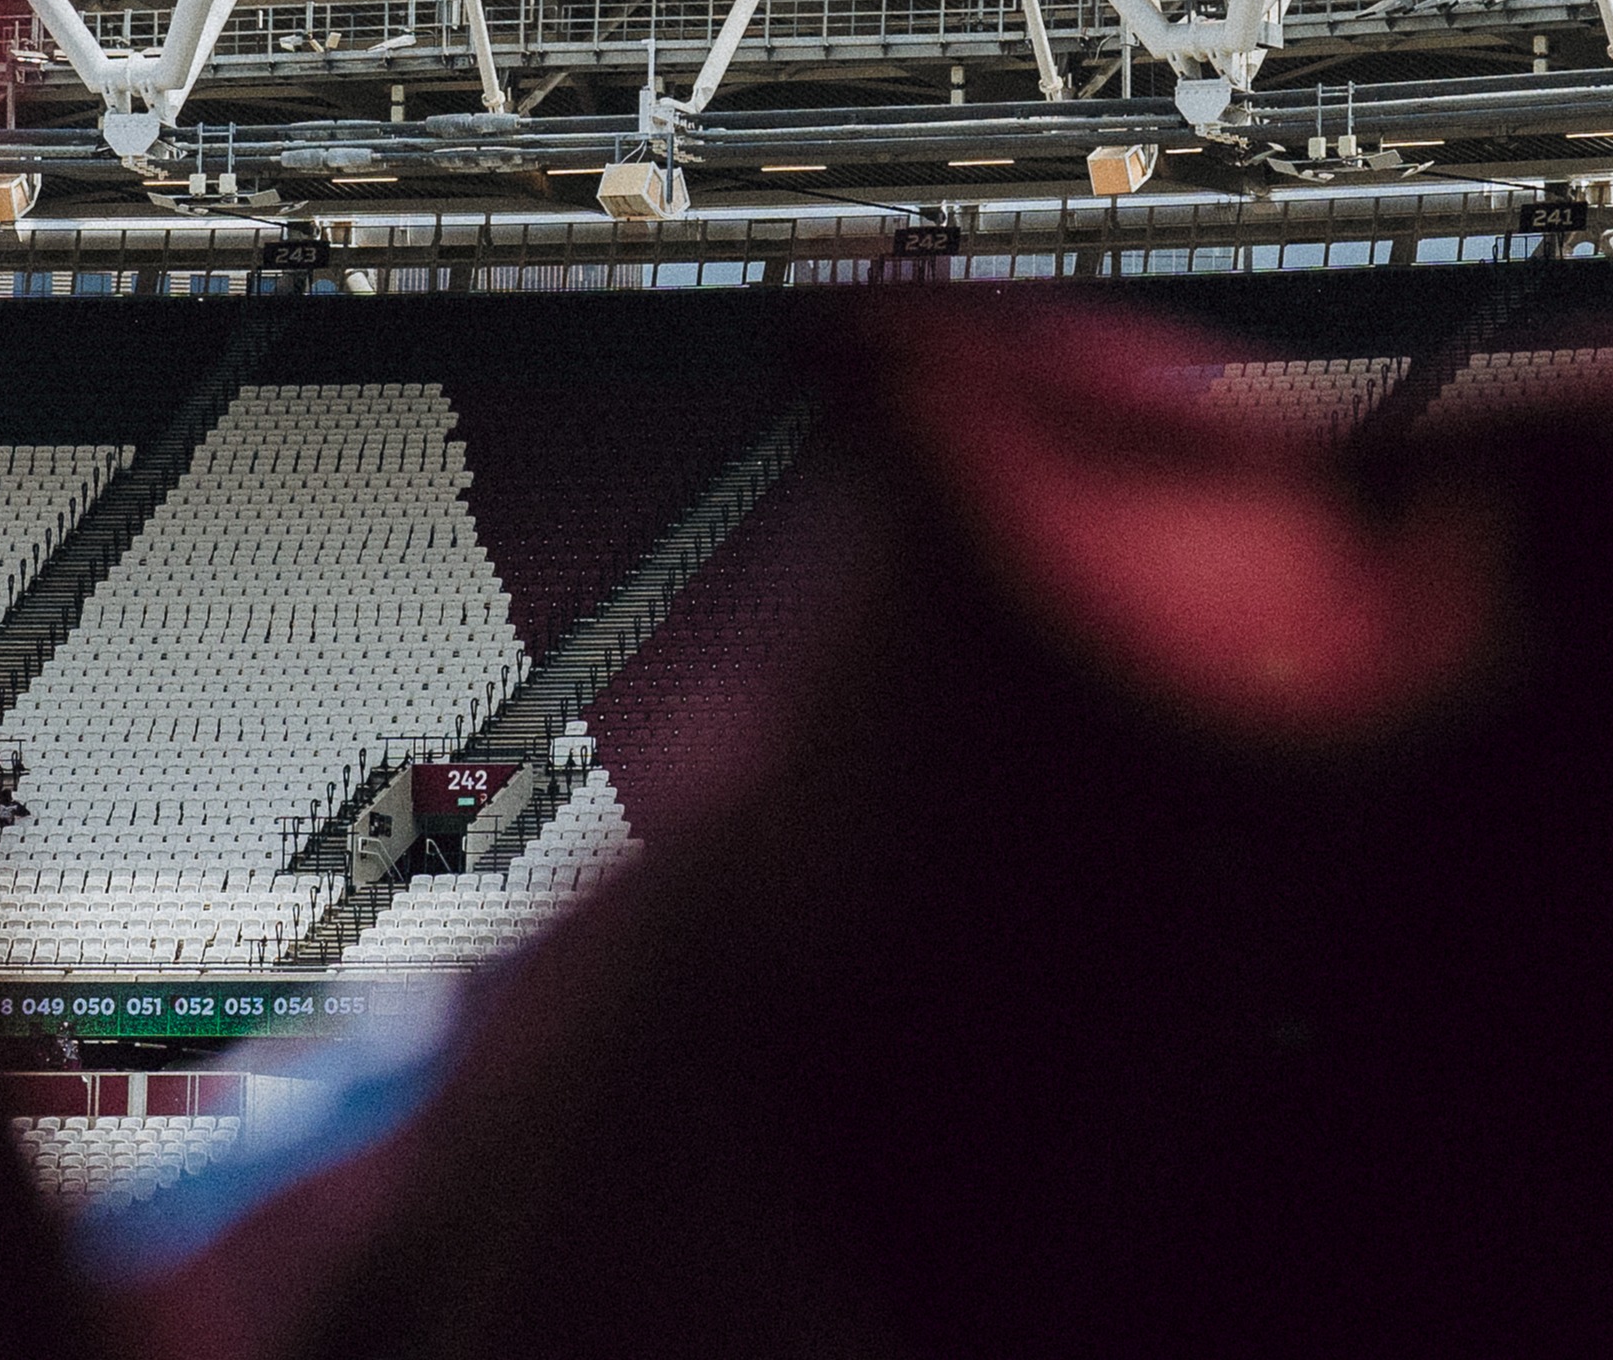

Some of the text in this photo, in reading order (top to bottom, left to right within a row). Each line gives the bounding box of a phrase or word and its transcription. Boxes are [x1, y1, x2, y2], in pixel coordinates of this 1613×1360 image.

[1533, 209, 1573, 226] 241
[905, 233, 948, 251] 242
[276, 247, 316, 263] 243
[448, 770, 487, 790] 242
[21, 997, 65, 1016] 049
[72, 997, 115, 1016] 050
[126, 997, 162, 1016] 051
[174, 997, 214, 1016] 052
[224, 997, 265, 1016] 053
[273, 997, 314, 1015] 054
[324, 997, 366, 1015] 055
